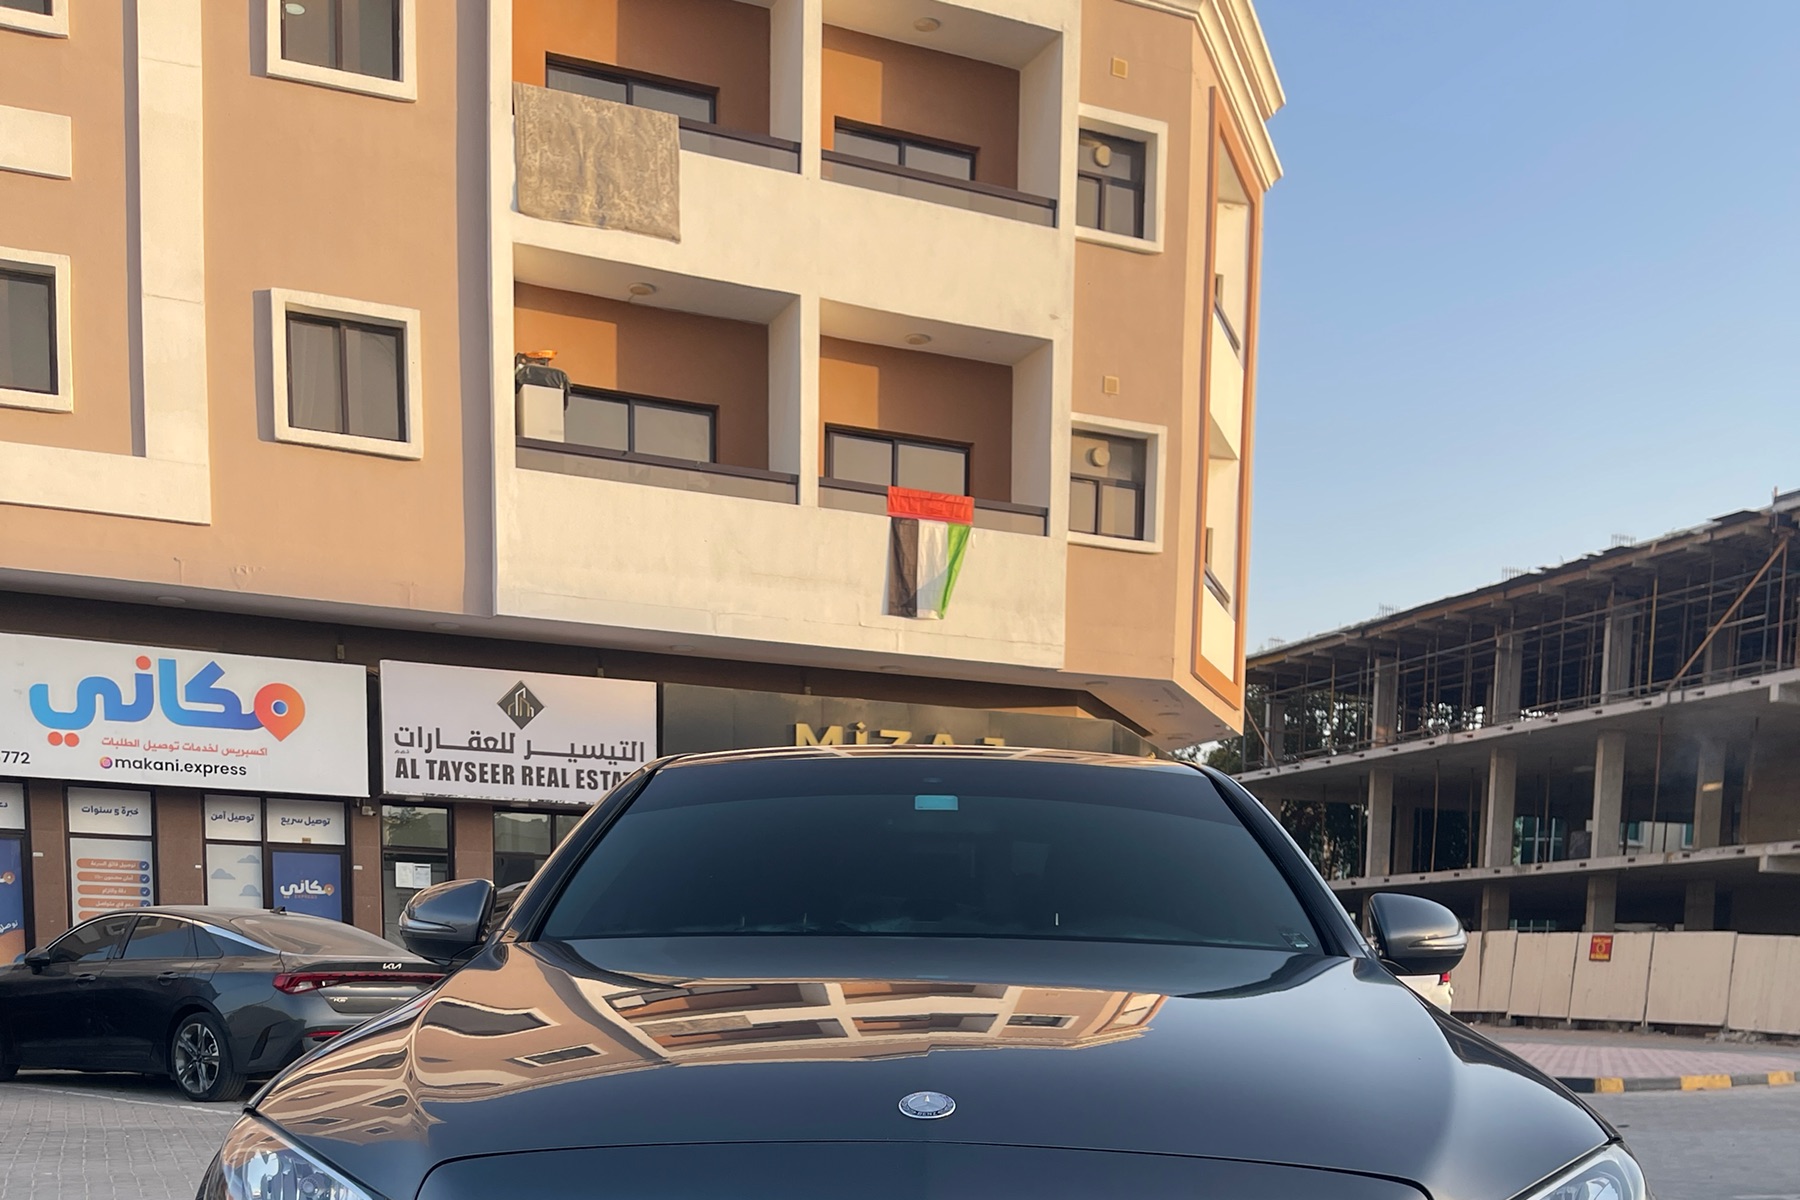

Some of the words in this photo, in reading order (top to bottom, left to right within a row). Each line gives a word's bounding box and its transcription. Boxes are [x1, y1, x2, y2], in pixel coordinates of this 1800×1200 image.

[29, 655, 305, 747] مكاني
[101, 736, 140, 748] الطلبات
[143, 739, 180, 753] توصيل
[394, 726, 515, 754] للعقارات
[182, 741, 218, 753] لخدمات
[222, 746, 268, 757] اكسبريس
[524, 739, 645, 766] التيسير
[1, 750, 30, 764] 772
[115, 757, 247, 777] makani.express
[395, 757, 420, 779] AL
[425, 759, 514, 785] TAYSEER
[521, 765, 569, 789] REAL
[81, 805, 112, 816] سنوات
[121, 805, 139, 817] خبرة
[210, 811, 226, 821] آمن
[227, 812, 255, 823] توصيل
[280, 816, 303, 826] سريع
[304, 816, 331, 827] توصيل
[280, 879, 335, 899] مكاني
[382, 962, 402, 970] KIA
